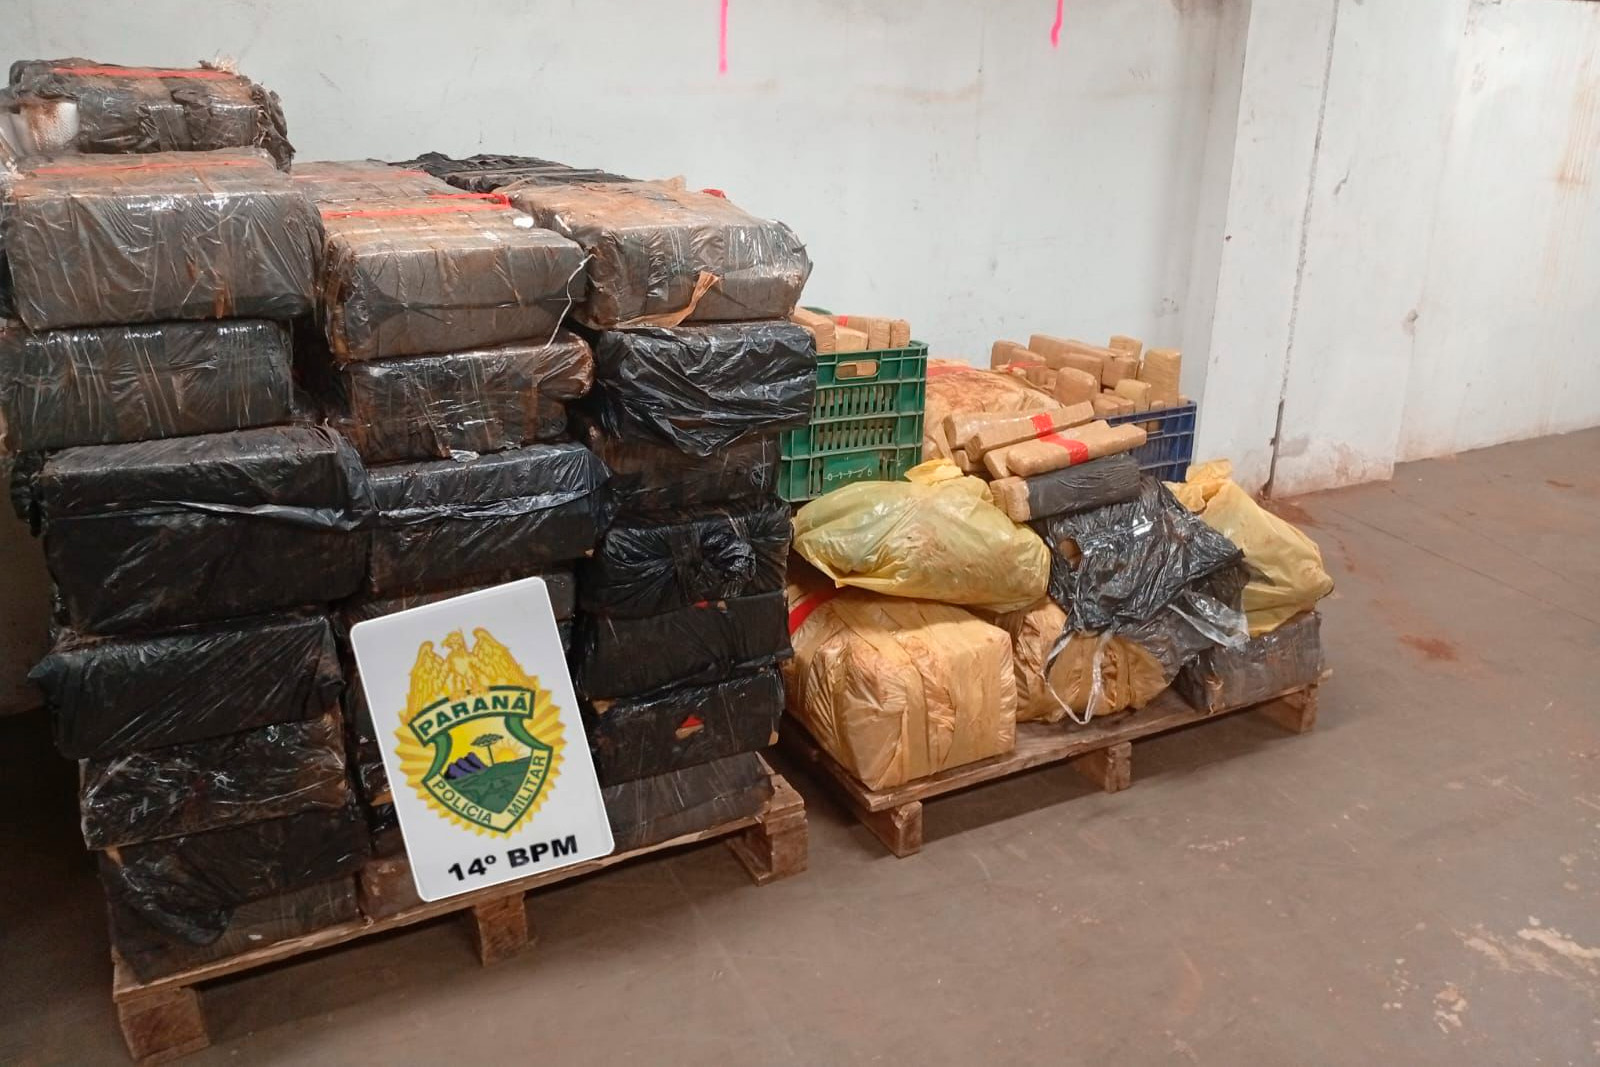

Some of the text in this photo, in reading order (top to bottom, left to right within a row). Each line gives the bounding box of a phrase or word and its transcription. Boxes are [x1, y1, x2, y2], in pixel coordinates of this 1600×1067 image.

[418, 693, 528, 736] PARANÁ
[507, 755, 546, 817] MILITAR
[507, 835, 578, 868] BPM
